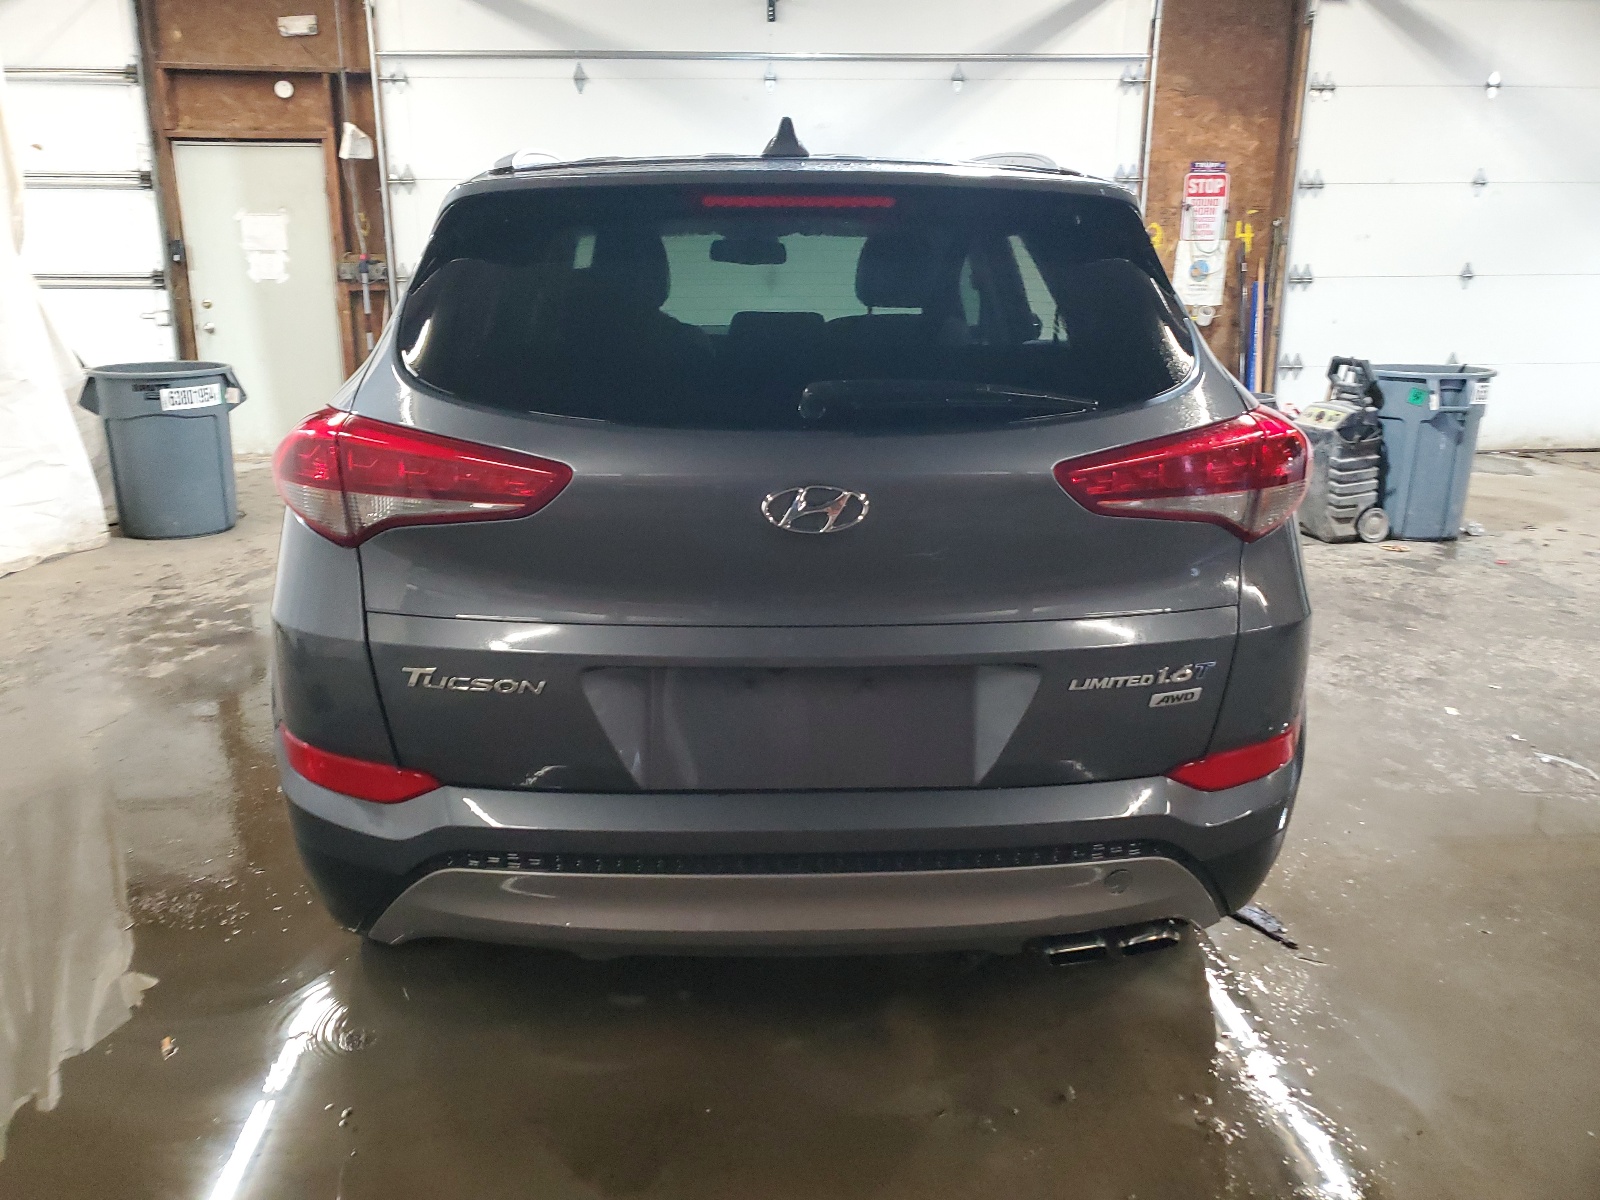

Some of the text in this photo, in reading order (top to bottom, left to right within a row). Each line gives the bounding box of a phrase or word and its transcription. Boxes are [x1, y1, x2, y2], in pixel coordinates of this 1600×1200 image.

[1188, 178, 1225, 194] STOP
[1234, 221, 1255, 252] 4
[402, 667, 546, 695] TUCSON
[1068, 674, 1154, 691] LIMITED
[1155, 691, 1195, 705] AWD
